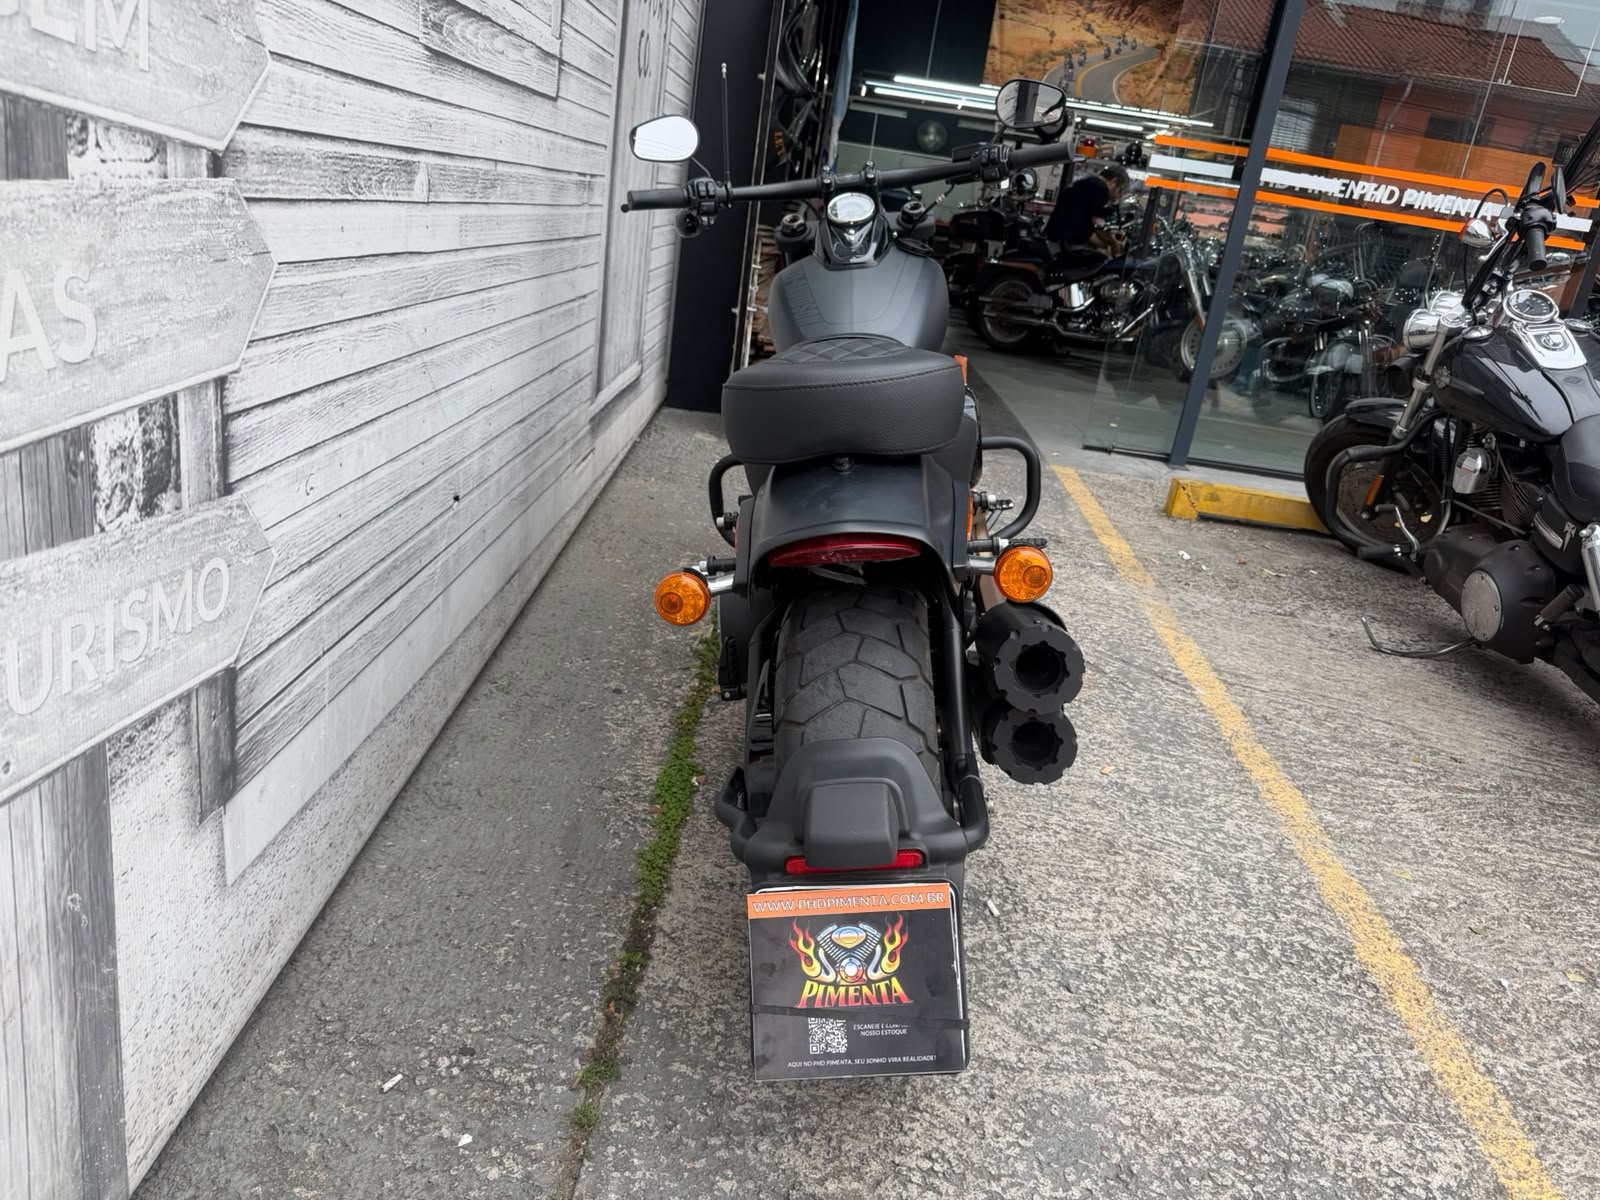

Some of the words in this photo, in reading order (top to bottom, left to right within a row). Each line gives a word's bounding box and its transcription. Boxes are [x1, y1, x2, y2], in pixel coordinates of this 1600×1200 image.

[752, 891, 945, 913] WWW.PHDPIMENTA.COM.BR
[794, 976, 914, 1009] PIMENTA
[881, 1028, 907, 1036] ESTOQUE
